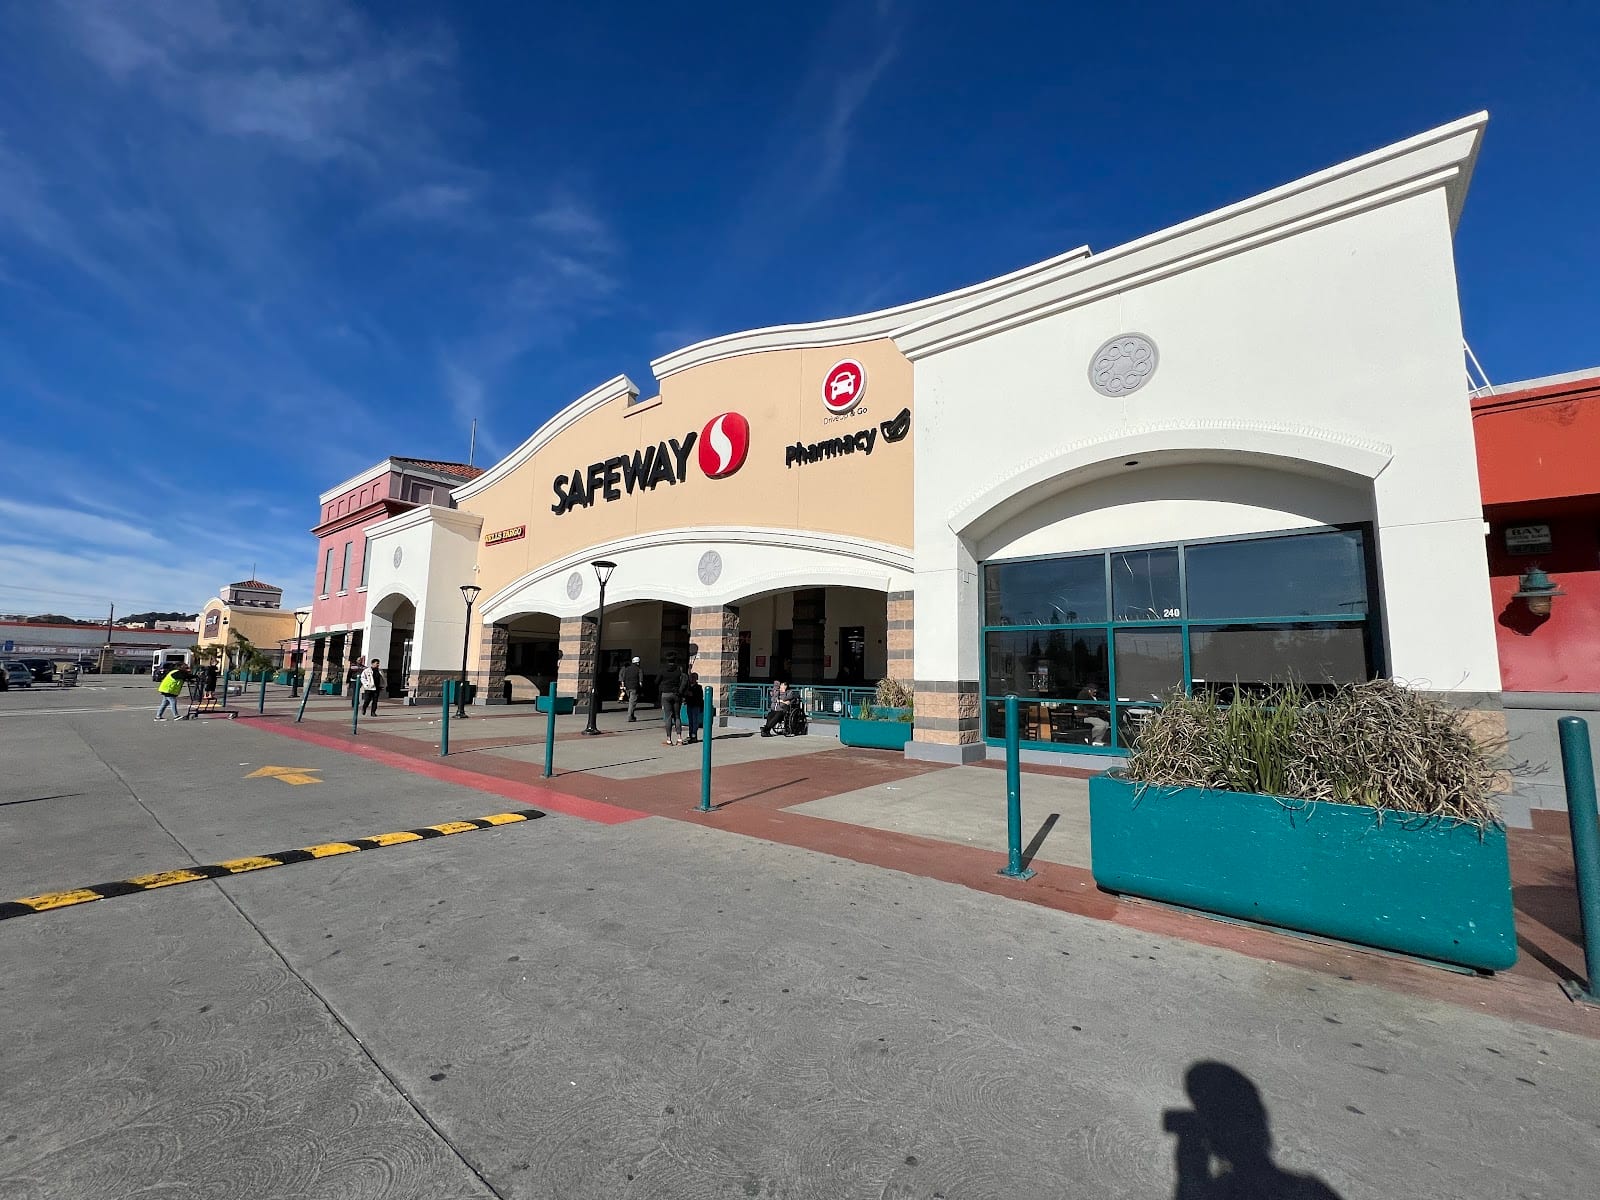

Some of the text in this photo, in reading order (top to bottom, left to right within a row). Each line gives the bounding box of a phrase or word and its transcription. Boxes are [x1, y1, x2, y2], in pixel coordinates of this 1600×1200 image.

[857, 407, 868, 415] Go
[785, 427, 877, 469] Pharmacy
[551, 431, 698, 516] SAFEWAY
[1163, 608, 1180, 618] 240
